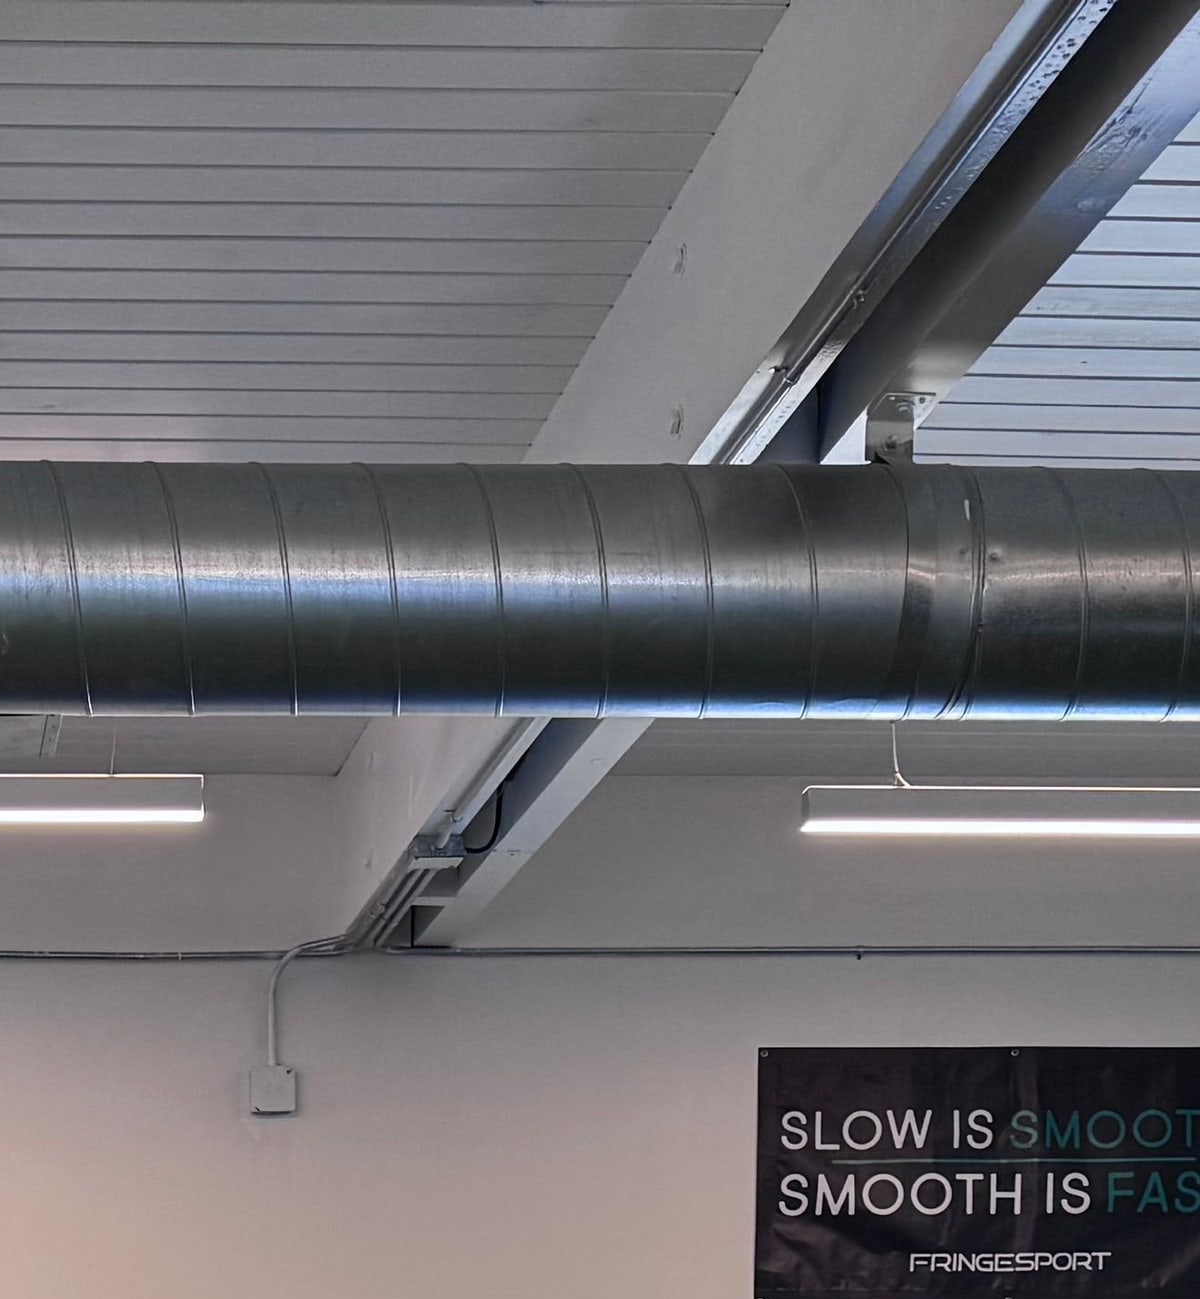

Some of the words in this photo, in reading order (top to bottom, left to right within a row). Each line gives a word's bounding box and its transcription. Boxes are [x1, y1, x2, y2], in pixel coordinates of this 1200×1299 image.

[780, 1109, 932, 1151] SLOW
[953, 1109, 994, 1149] IS
[778, 1172, 1023, 1217] SMOOTH
[1046, 1171, 1091, 1215] IS
[909, 1251, 1112, 1272] FRINGESPORT
